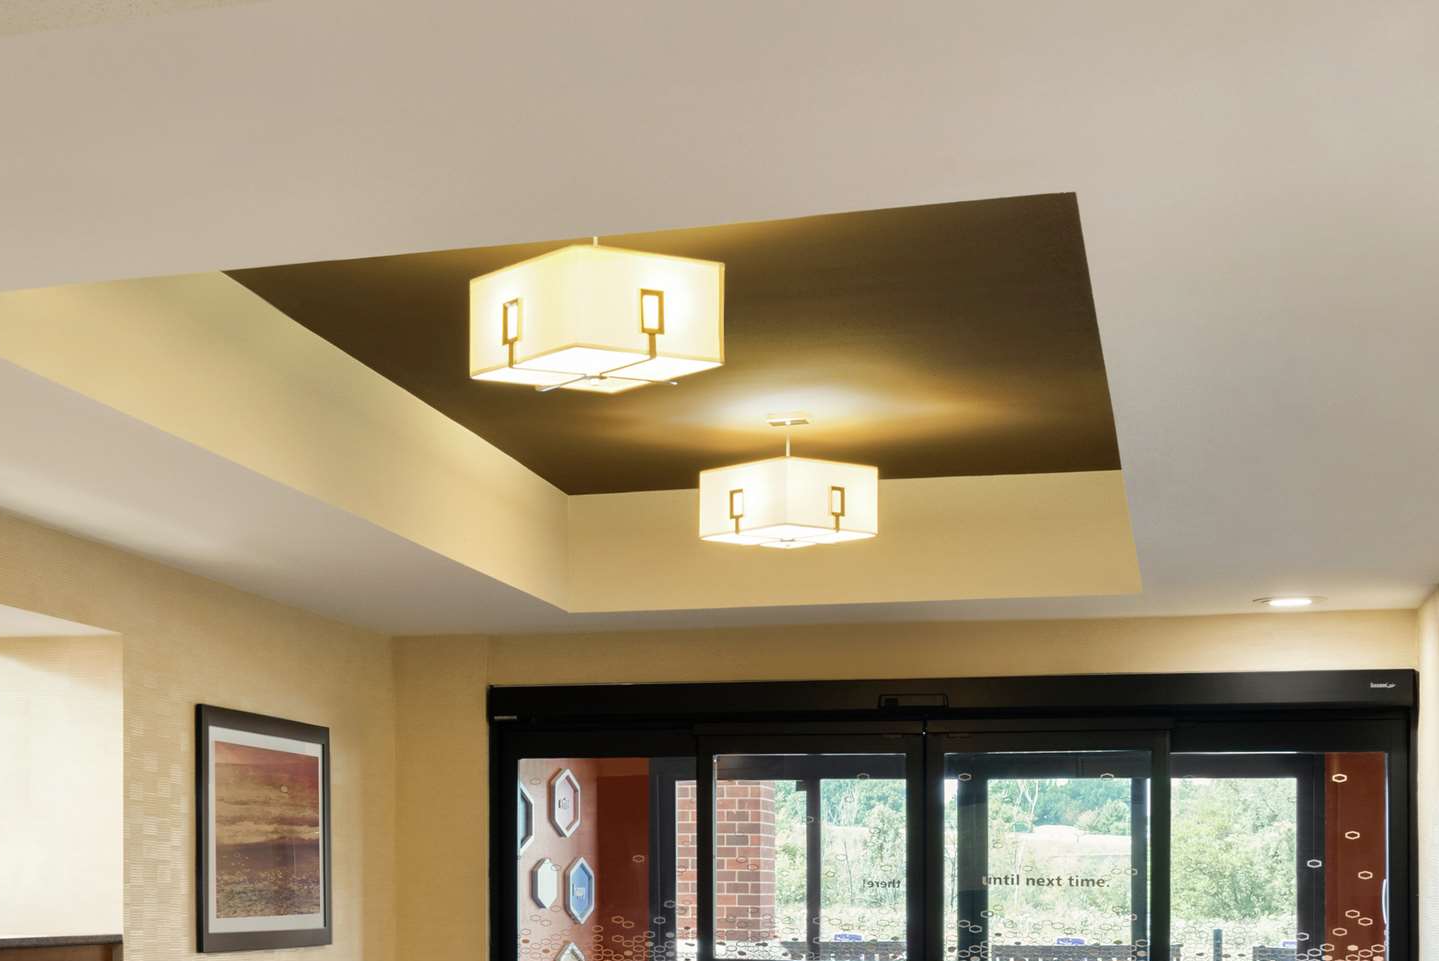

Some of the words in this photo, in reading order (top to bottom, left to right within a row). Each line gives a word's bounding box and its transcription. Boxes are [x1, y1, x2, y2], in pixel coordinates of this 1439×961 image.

[982, 874, 1020, 886] until
[1026, 876, 1063, 887] next
[1068, 875, 1111, 888] time.
